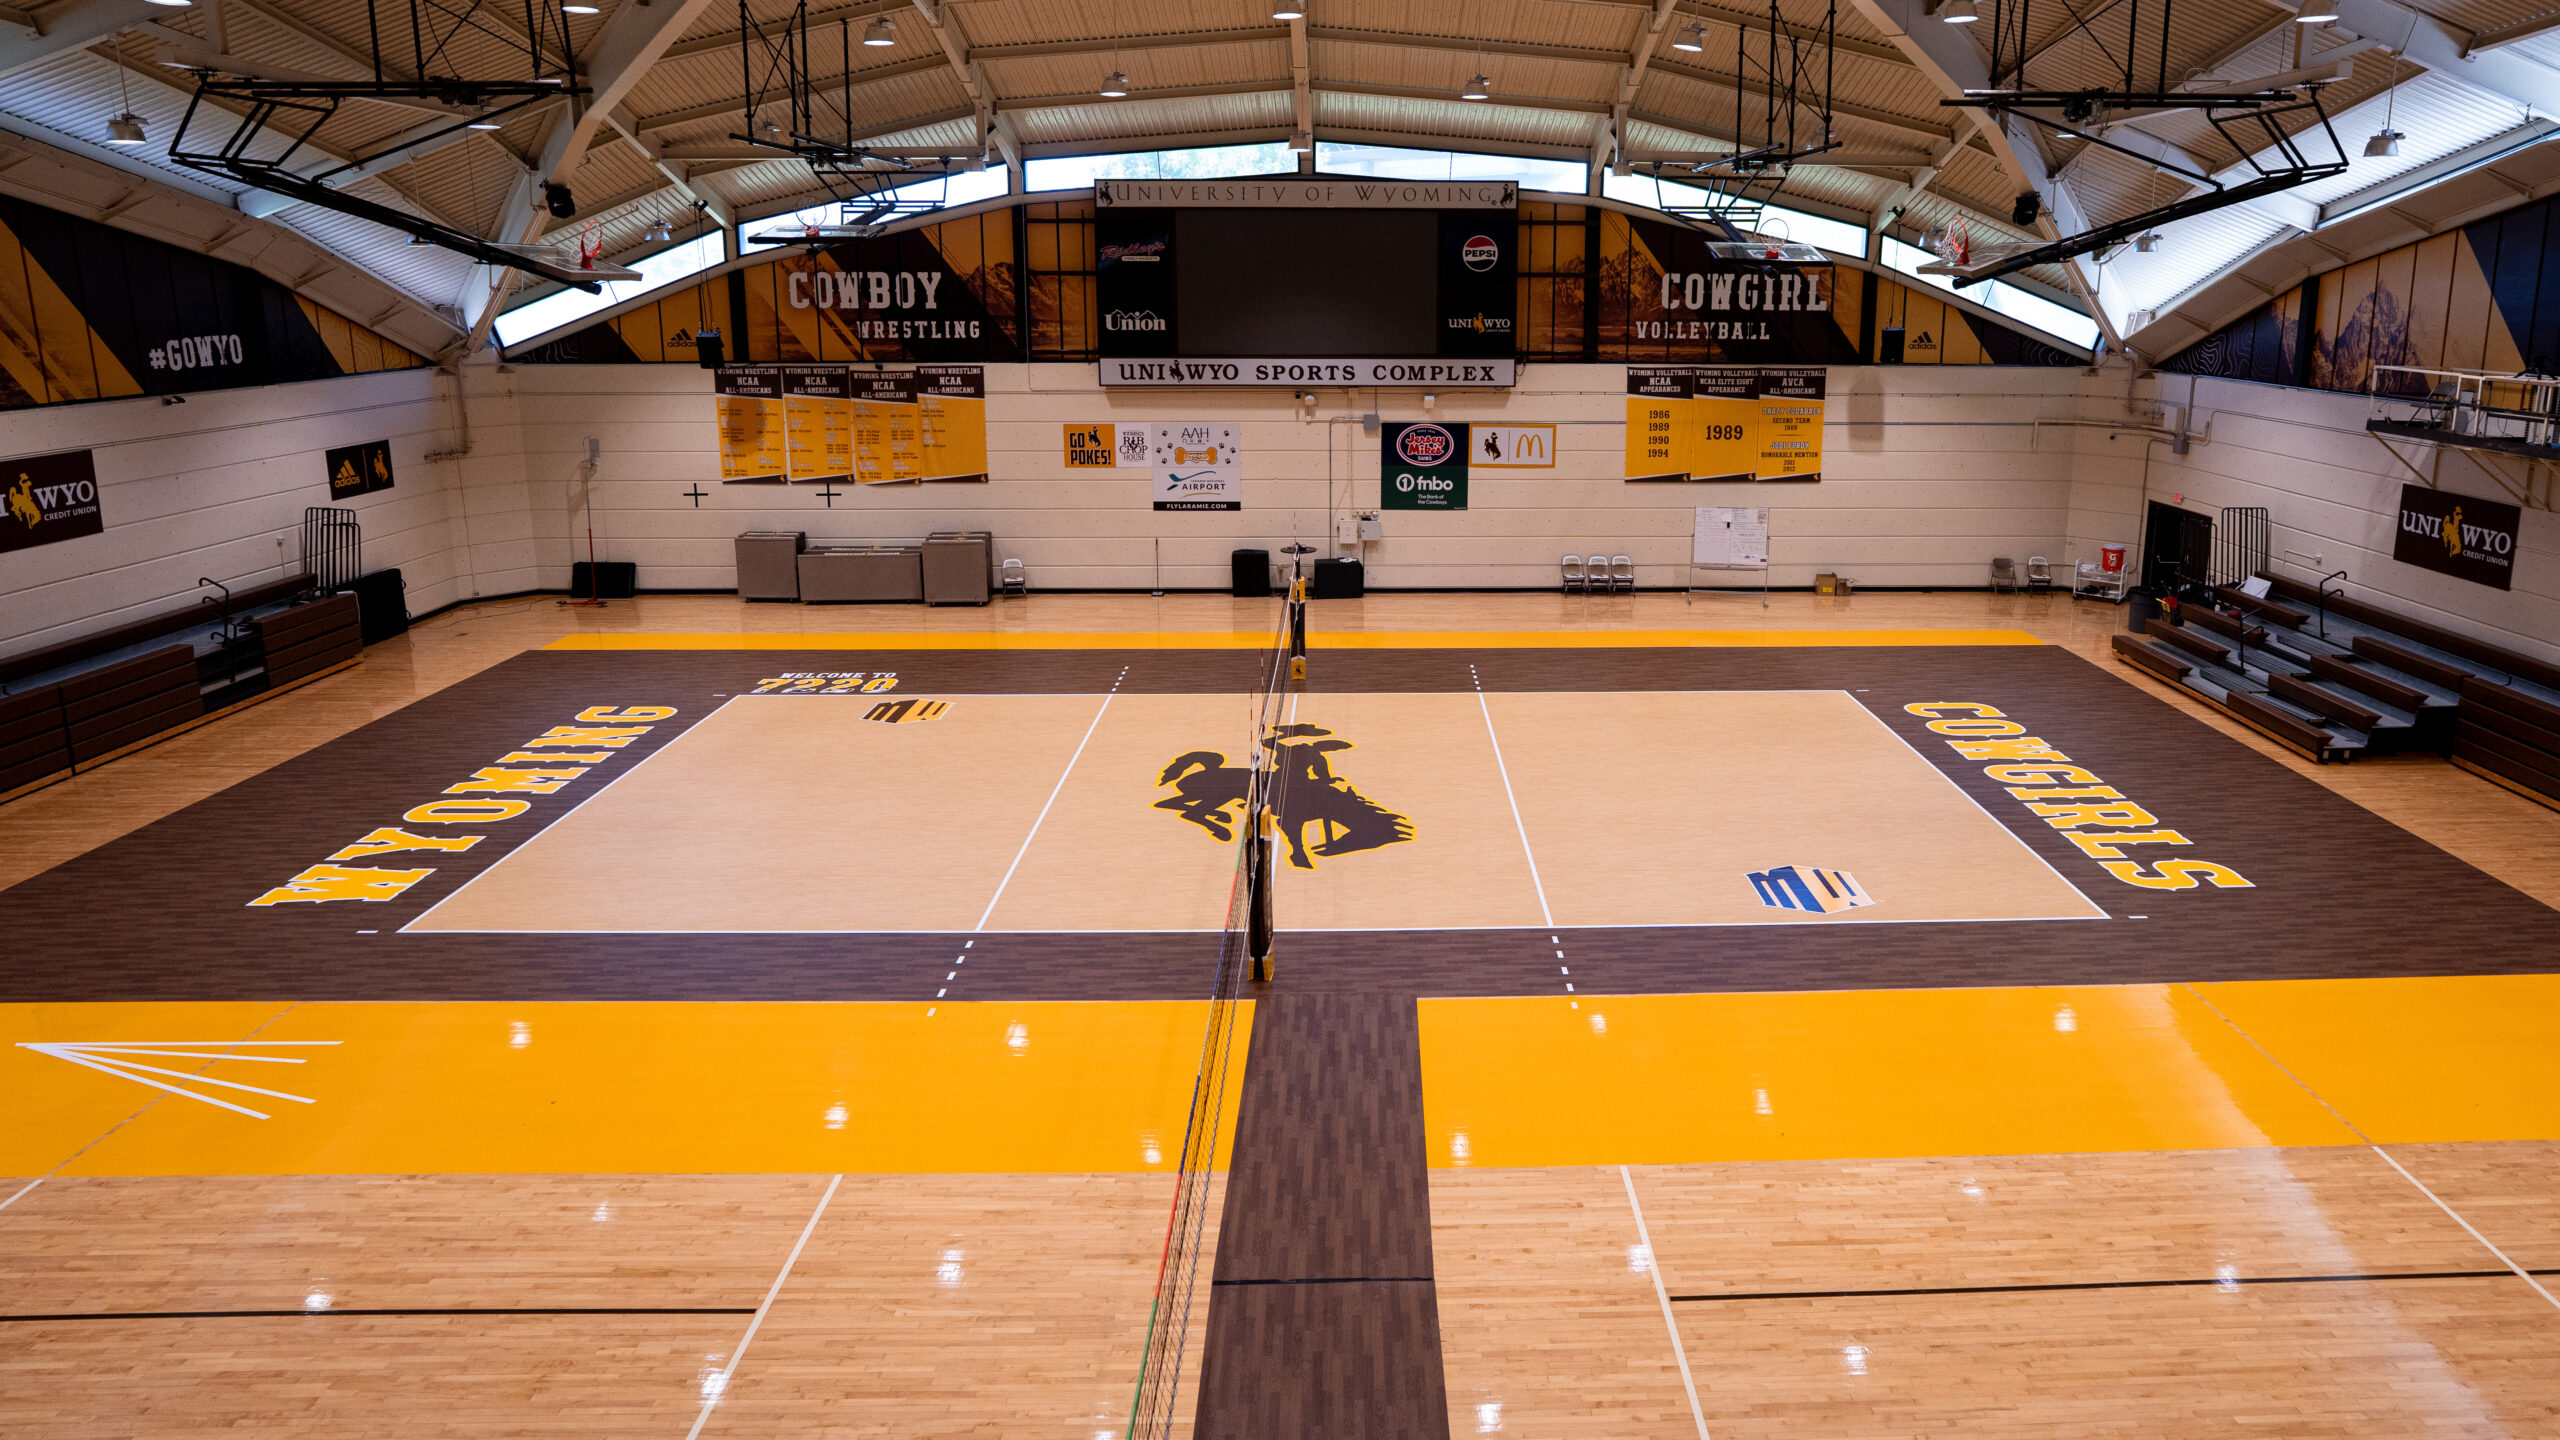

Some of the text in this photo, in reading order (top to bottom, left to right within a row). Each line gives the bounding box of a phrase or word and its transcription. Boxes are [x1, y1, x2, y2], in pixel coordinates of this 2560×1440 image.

[1116, 184, 1491, 203] UNIVERSITY OF WYOMING
[1100, 241, 1166, 260] Ridley's
[1465, 250, 1496, 258] PEPSI
[788, 271, 942, 309] COWBOY
[1661, 272, 1828, 311] COWGIRL
[1104, 310, 1166, 331] Union
[856, 320, 980, 339] WRESTLING
[1635, 321, 1770, 340] VOLLEYBALL
[149, 334, 243, 371] #GOWYO
[737, 377, 759, 385] NCAA
[804, 377, 827, 385] NCAA
[939, 377, 962, 385] NCAA
[1256, 365, 1356, 380] SPORTS
[1372, 365, 1495, 381] COMPLEX
[872, 382, 895, 390] NCAA
[1649, 377, 1671, 386] NCAA
[1782, 378, 1804, 386] AVCA
[1649, 410, 1670, 419] 1986
[1648, 423, 1670, 431] 1989
[1706, 425, 1743, 440] 1989
[1069, 432, 1085, 448] GO
[1406, 432, 1446, 447] Jersey
[1648, 436, 1669, 445] 1990
[1070, 449, 1112, 465] POKES!
[1407, 443, 1444, 455] Mike's
[1647, 449, 1669, 458] 1994
[334, 475, 361, 488] adidas
[1416, 475, 1453, 491] fnbo
[33, 480, 95, 510] WYO
[44, 505, 97, 521] CREDIT UNION
[2462, 549, 2509, 567] CREDIT UNION
[750, 678, 899, 694] 7220
[1903, 701, 2257, 891] COWGIRLS
[245, 704, 679, 907] WYOMING
